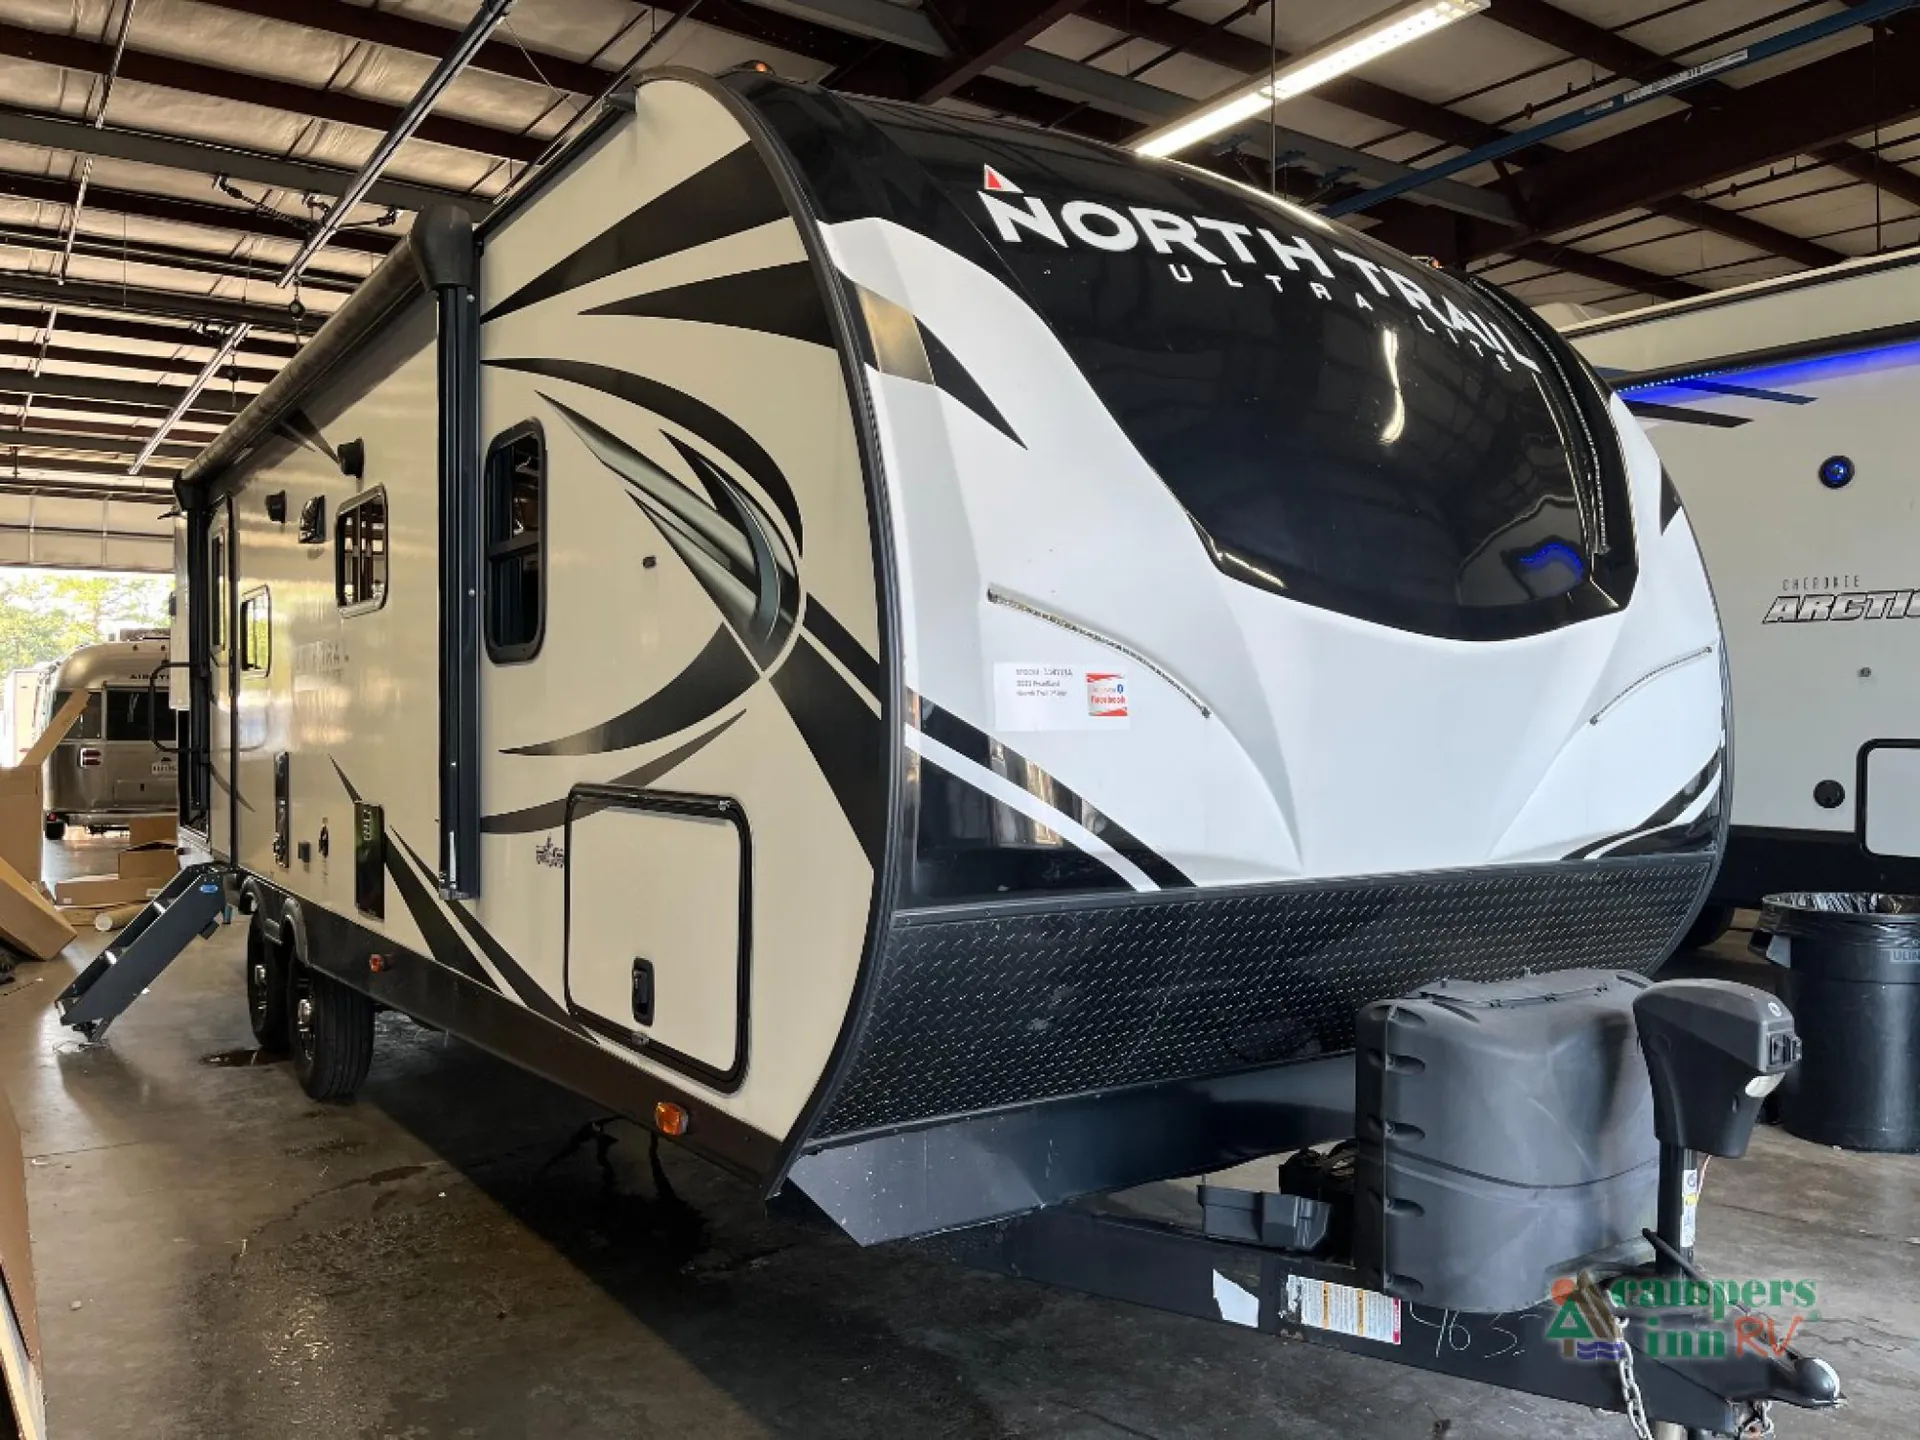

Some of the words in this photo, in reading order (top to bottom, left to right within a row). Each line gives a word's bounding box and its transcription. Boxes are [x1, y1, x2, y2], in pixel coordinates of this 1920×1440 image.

[977, 190, 1335, 279] NORTH
[1333, 248, 1542, 374] TRAIL
[1168, 264, 1374, 311] ULTRA
[1416, 314, 1512, 372] LITE
